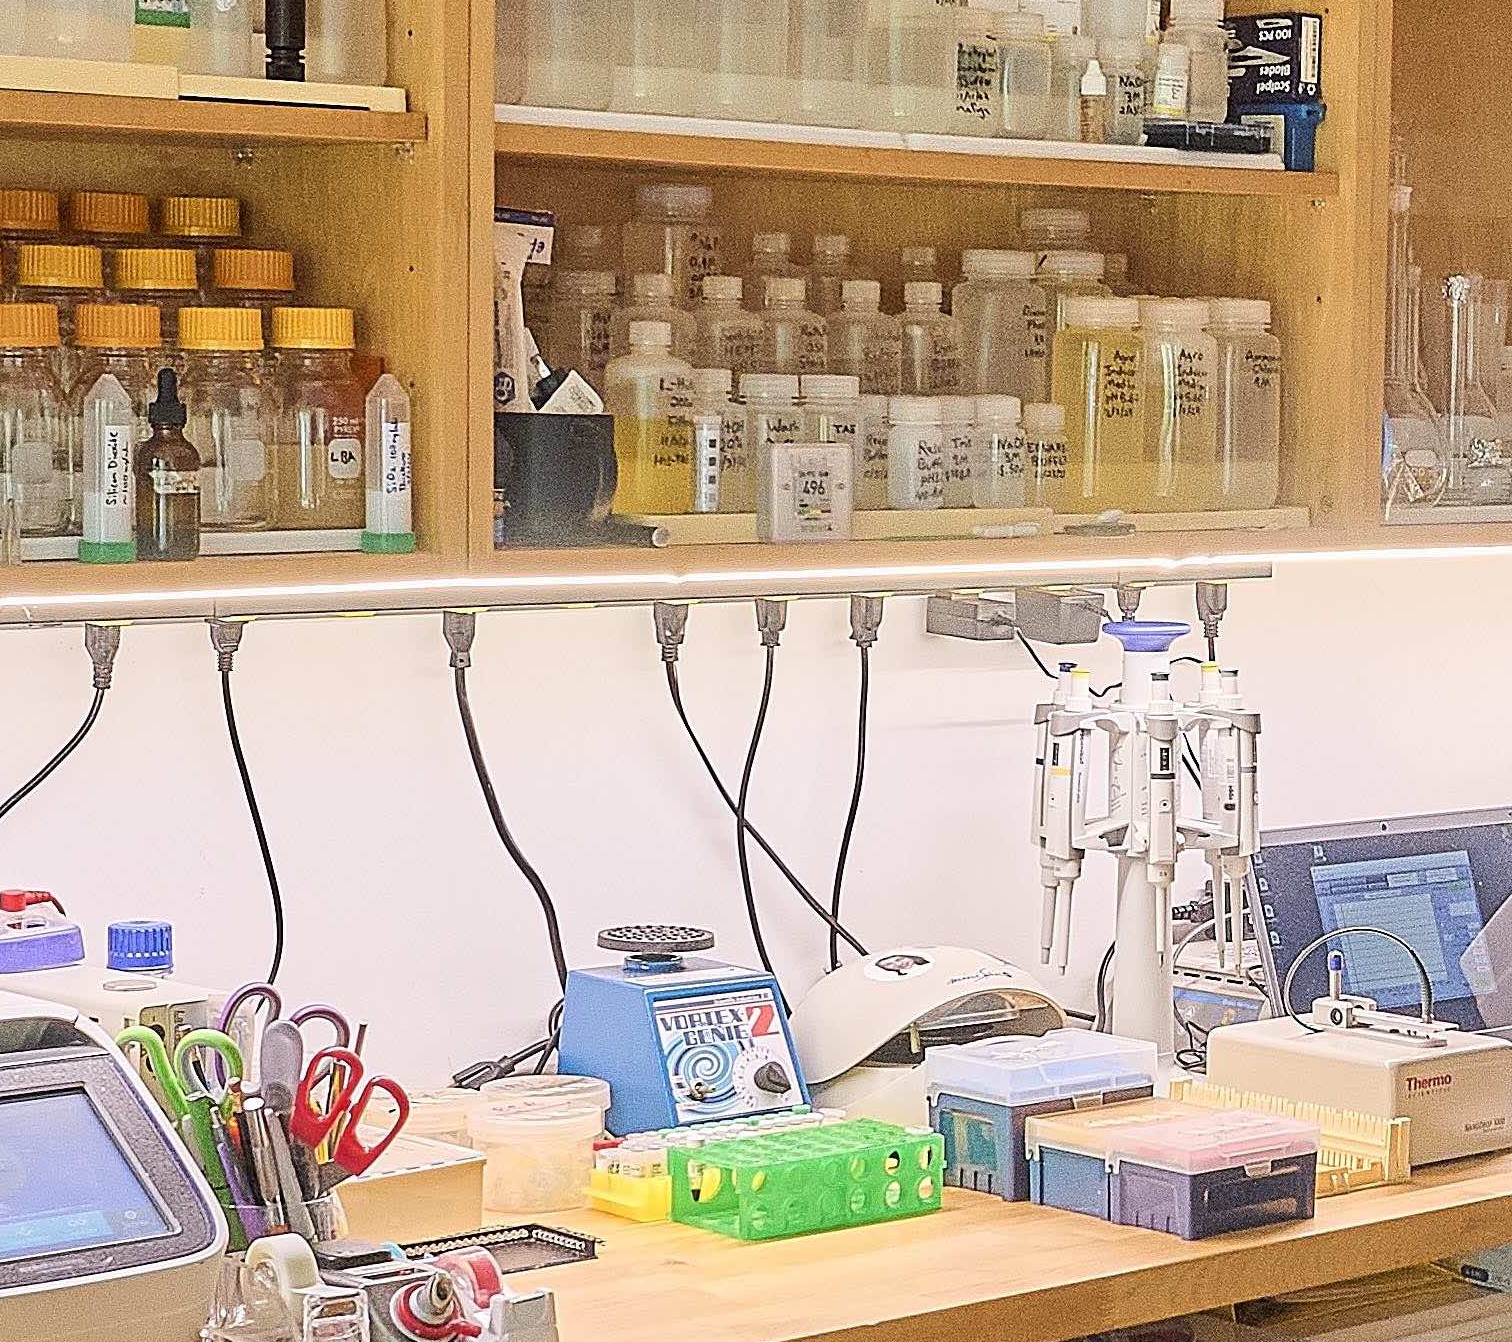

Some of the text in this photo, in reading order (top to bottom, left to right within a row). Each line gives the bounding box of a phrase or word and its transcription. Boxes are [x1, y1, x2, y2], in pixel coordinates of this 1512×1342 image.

[1276, 30, 1292, 40] 100
[1259, 63, 1291, 76] Blades
[1256, 79, 1291, 93] Scalpel
[106, 472, 118, 506] Silicon
[803, 480, 825, 495] 496
[660, 1009, 742, 1031] VORTEX
[683, 1004, 780, 1046] GENIE 2
[1406, 1075, 1452, 1091] Thermo
